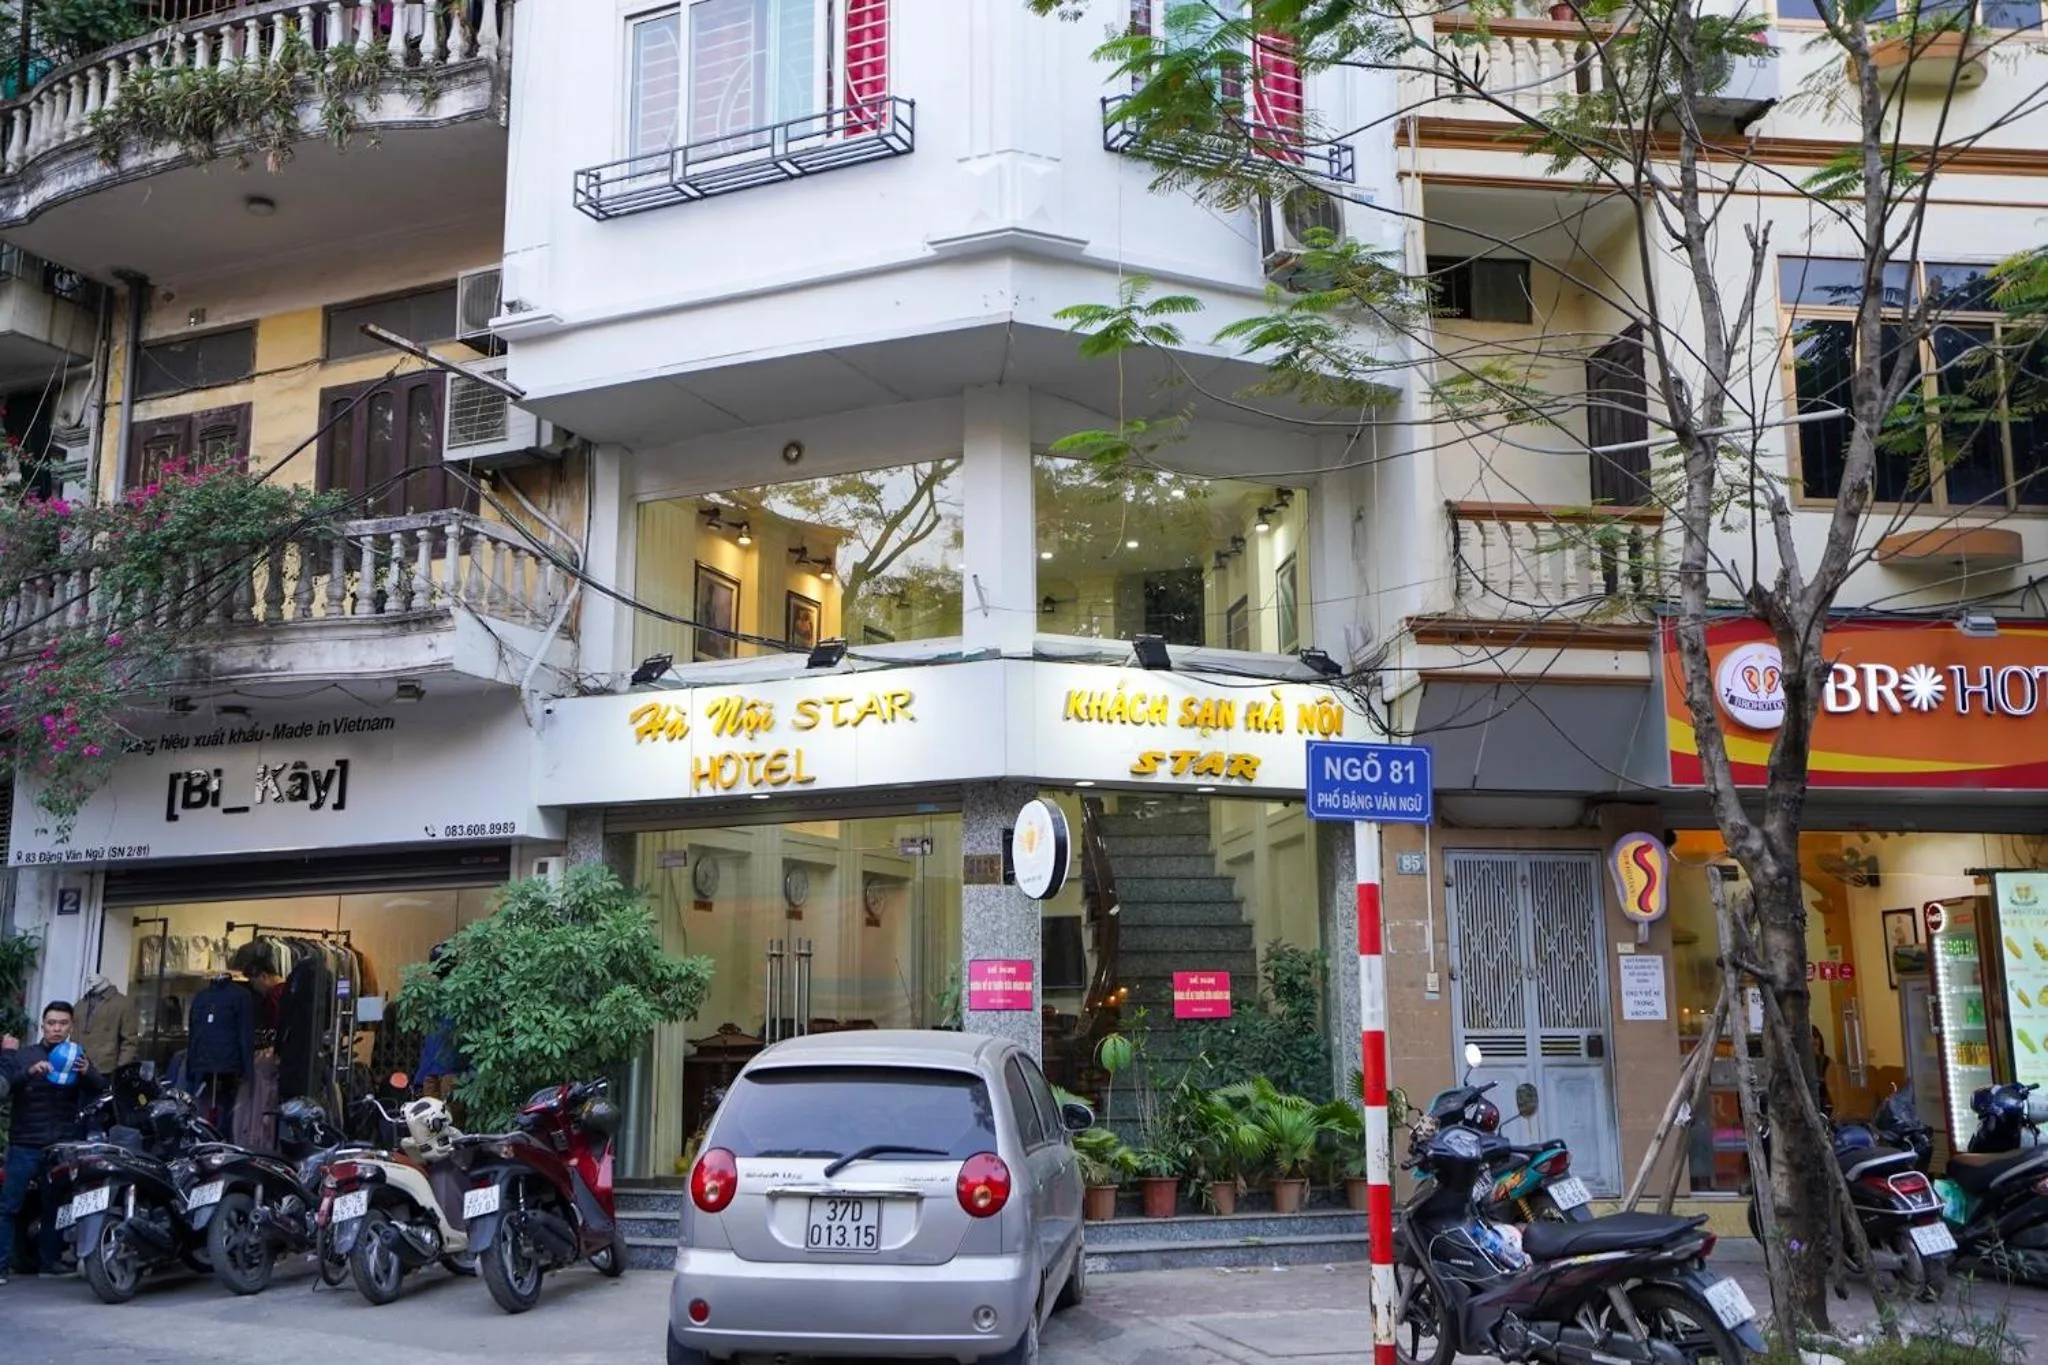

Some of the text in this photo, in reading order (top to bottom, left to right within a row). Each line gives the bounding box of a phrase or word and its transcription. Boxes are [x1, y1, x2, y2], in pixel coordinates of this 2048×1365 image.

[630, 689, 917, 744] Hà Nội STAR
[1065, 679, 1344, 740] KHÁCH SẠN HÀ NỘI
[317, 717, 331, 736] in
[334, 715, 395, 736] Vietnam
[692, 748, 816, 793] HOTEL
[1130, 749, 1262, 781] STAR
[1324, 752, 1415, 784] NGÕ 81
[1317, 787, 1423, 812] PHỐ ĐẶNG VĂN NGỮ
[445, 821, 516, 837] 083.608.8989
[25, 852, 36, 863] 83
[108, 845, 125, 858] (SN
[127, 843, 150, 857] 2/81)
[1402, 855, 1421, 870] 85
[62, 892, 77, 911] 2
[826, 1200, 863, 1222] 37D
[810, 1225, 875, 1247] 013.15
